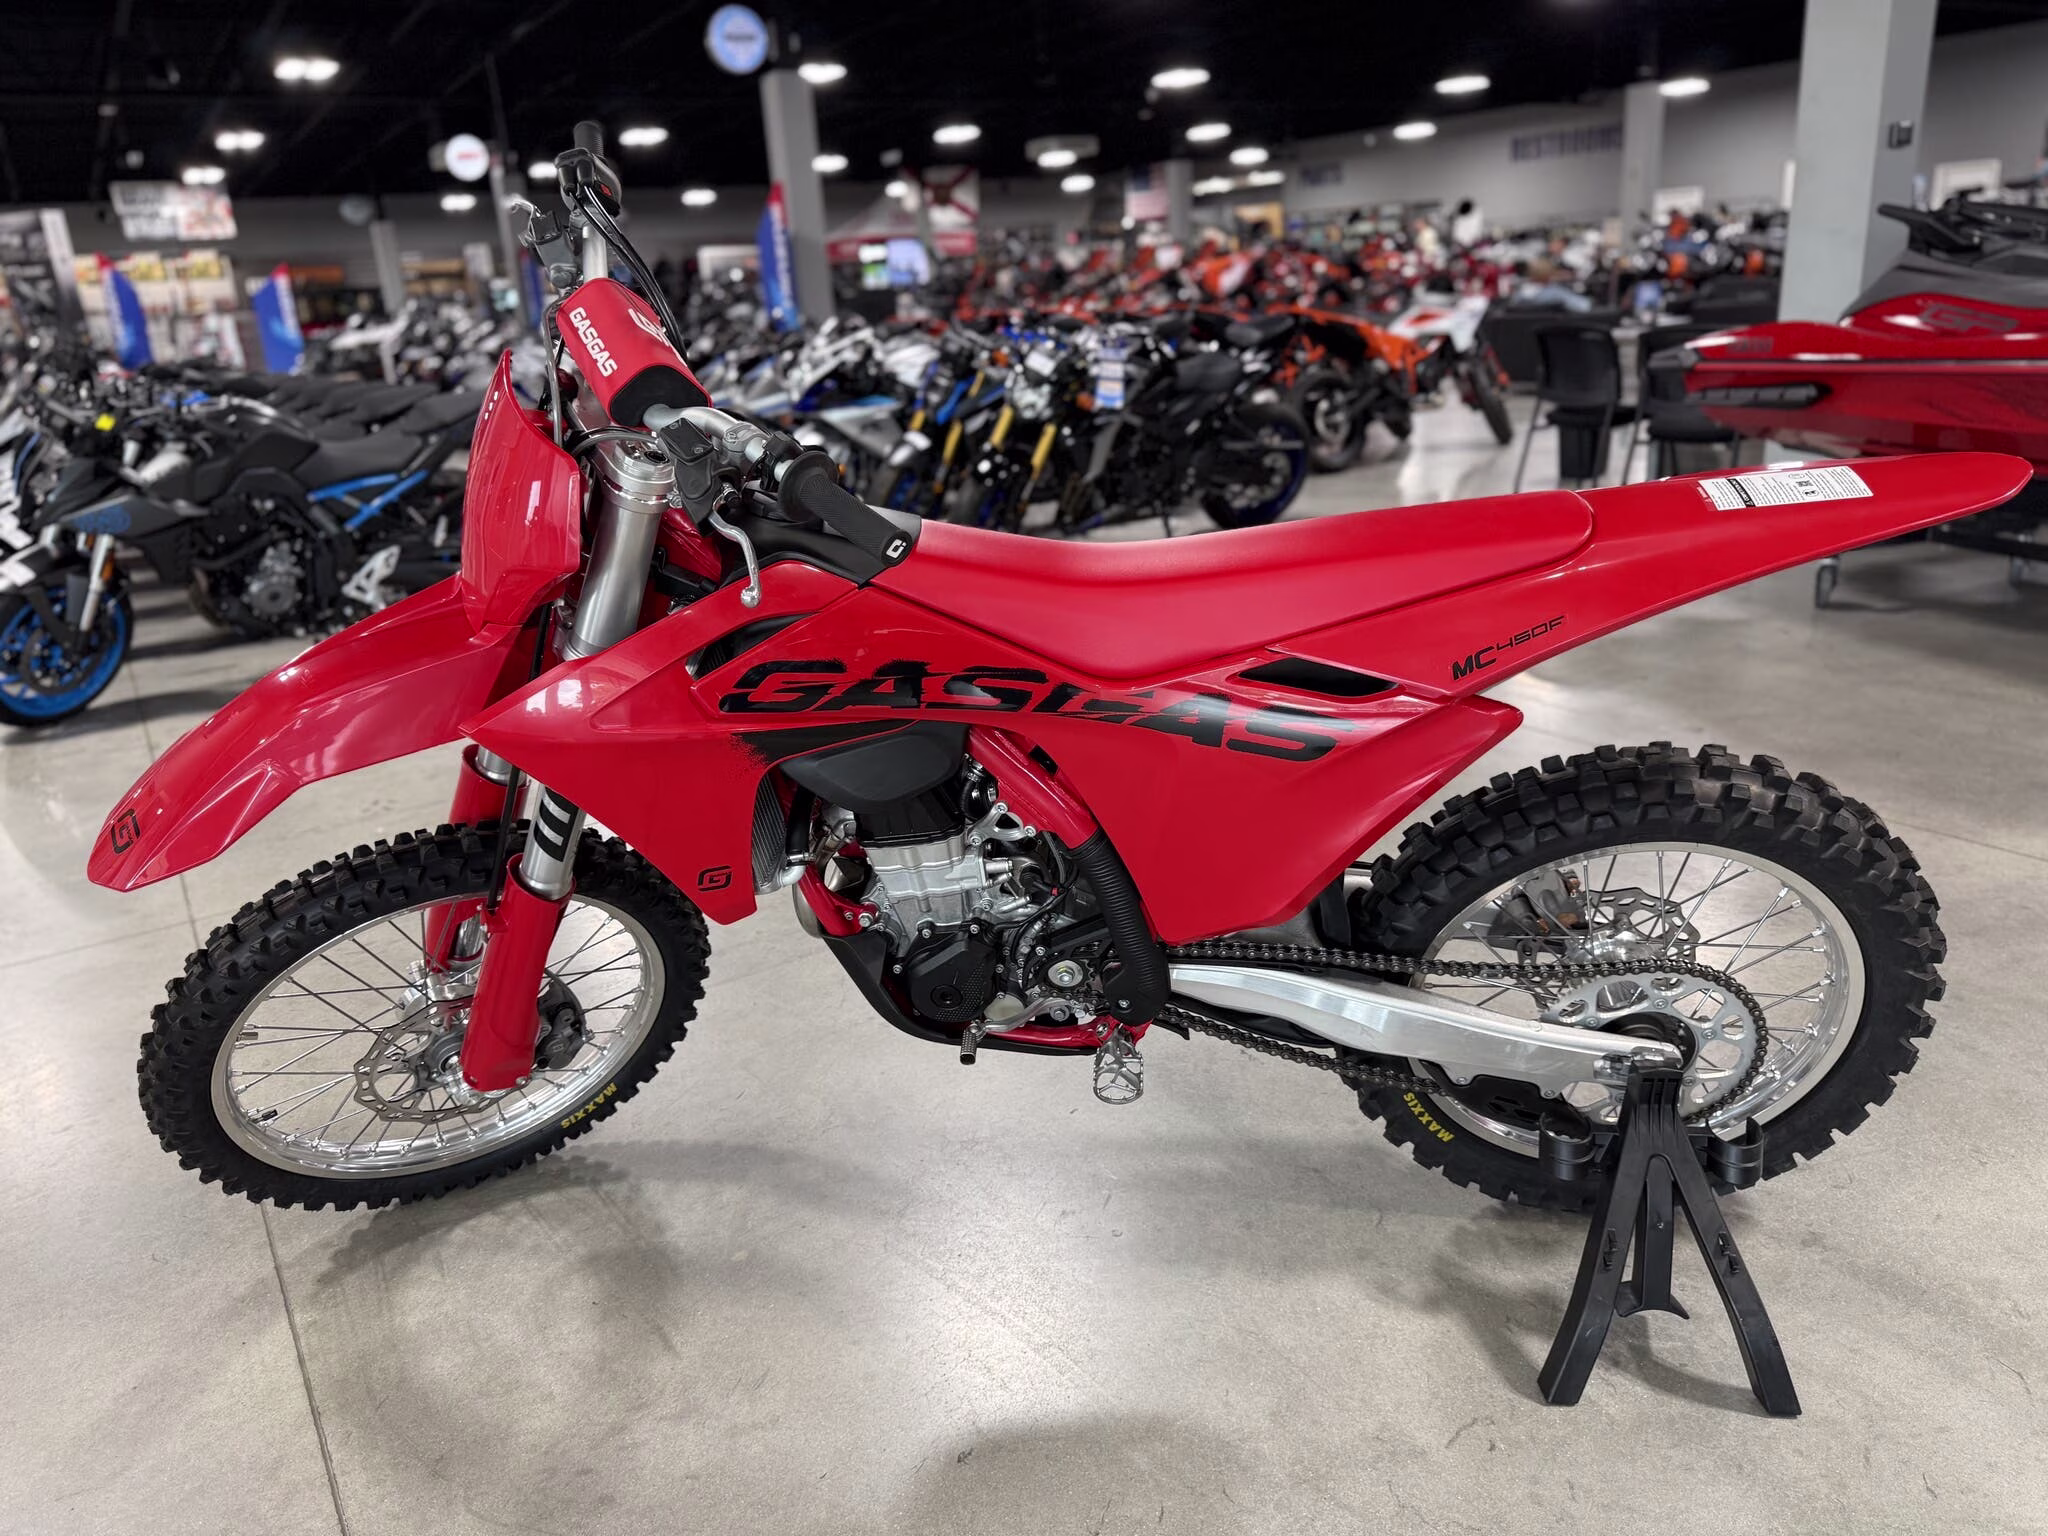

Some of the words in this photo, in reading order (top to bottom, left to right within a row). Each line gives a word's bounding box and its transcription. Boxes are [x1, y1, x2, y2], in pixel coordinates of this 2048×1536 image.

[569, 306, 618, 378] GASGAS
[718, 657, 1356, 762] GASGAS
[560, 1082, 617, 1129] MAXXIS
[1403, 1091, 1455, 1142] MAXXIS
